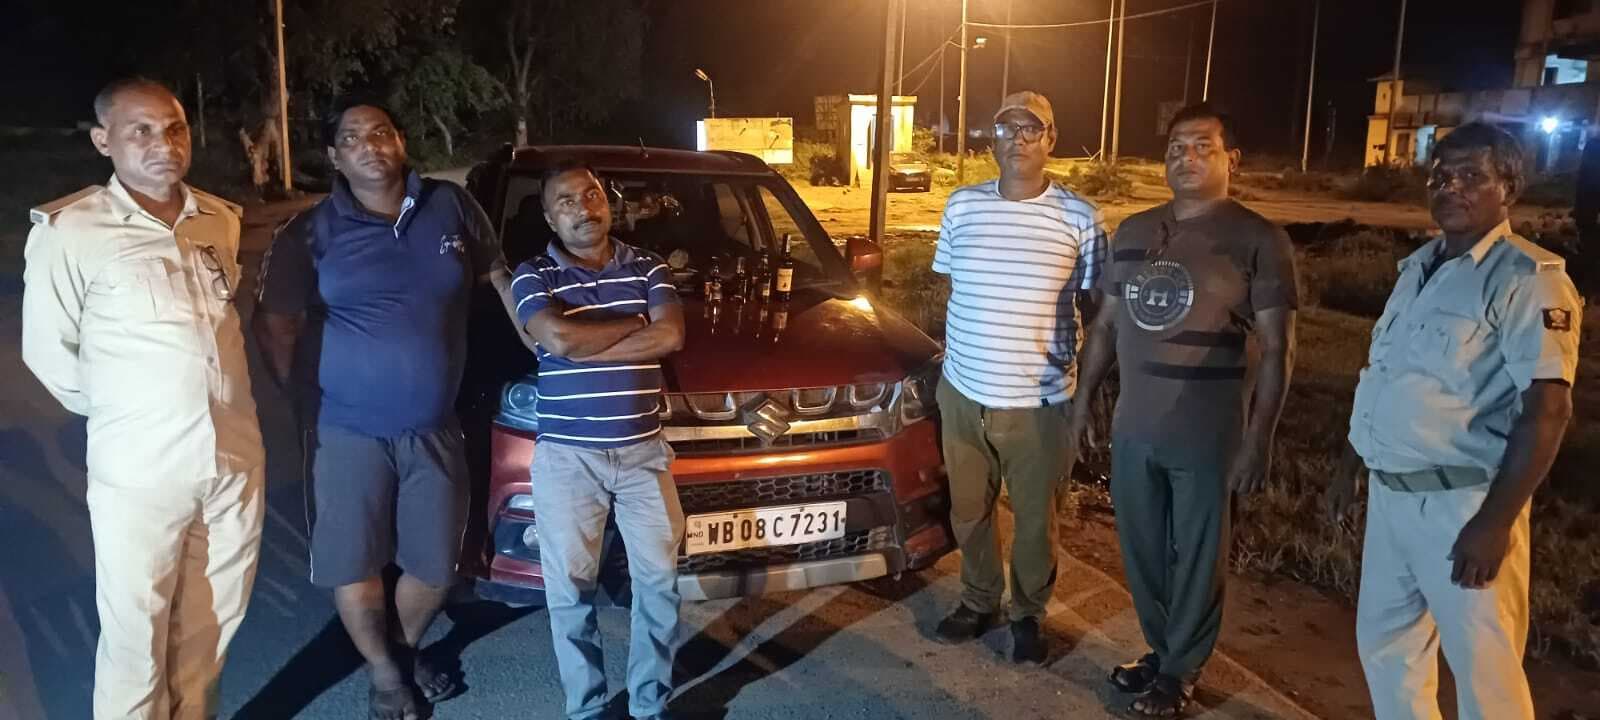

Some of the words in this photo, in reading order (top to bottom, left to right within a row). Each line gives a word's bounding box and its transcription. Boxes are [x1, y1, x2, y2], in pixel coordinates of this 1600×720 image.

[708, 521, 734, 545] WB
[741, 518, 766, 541] 08
[773, 516, 783, 538] C
[790, 510, 840, 537] 7231
